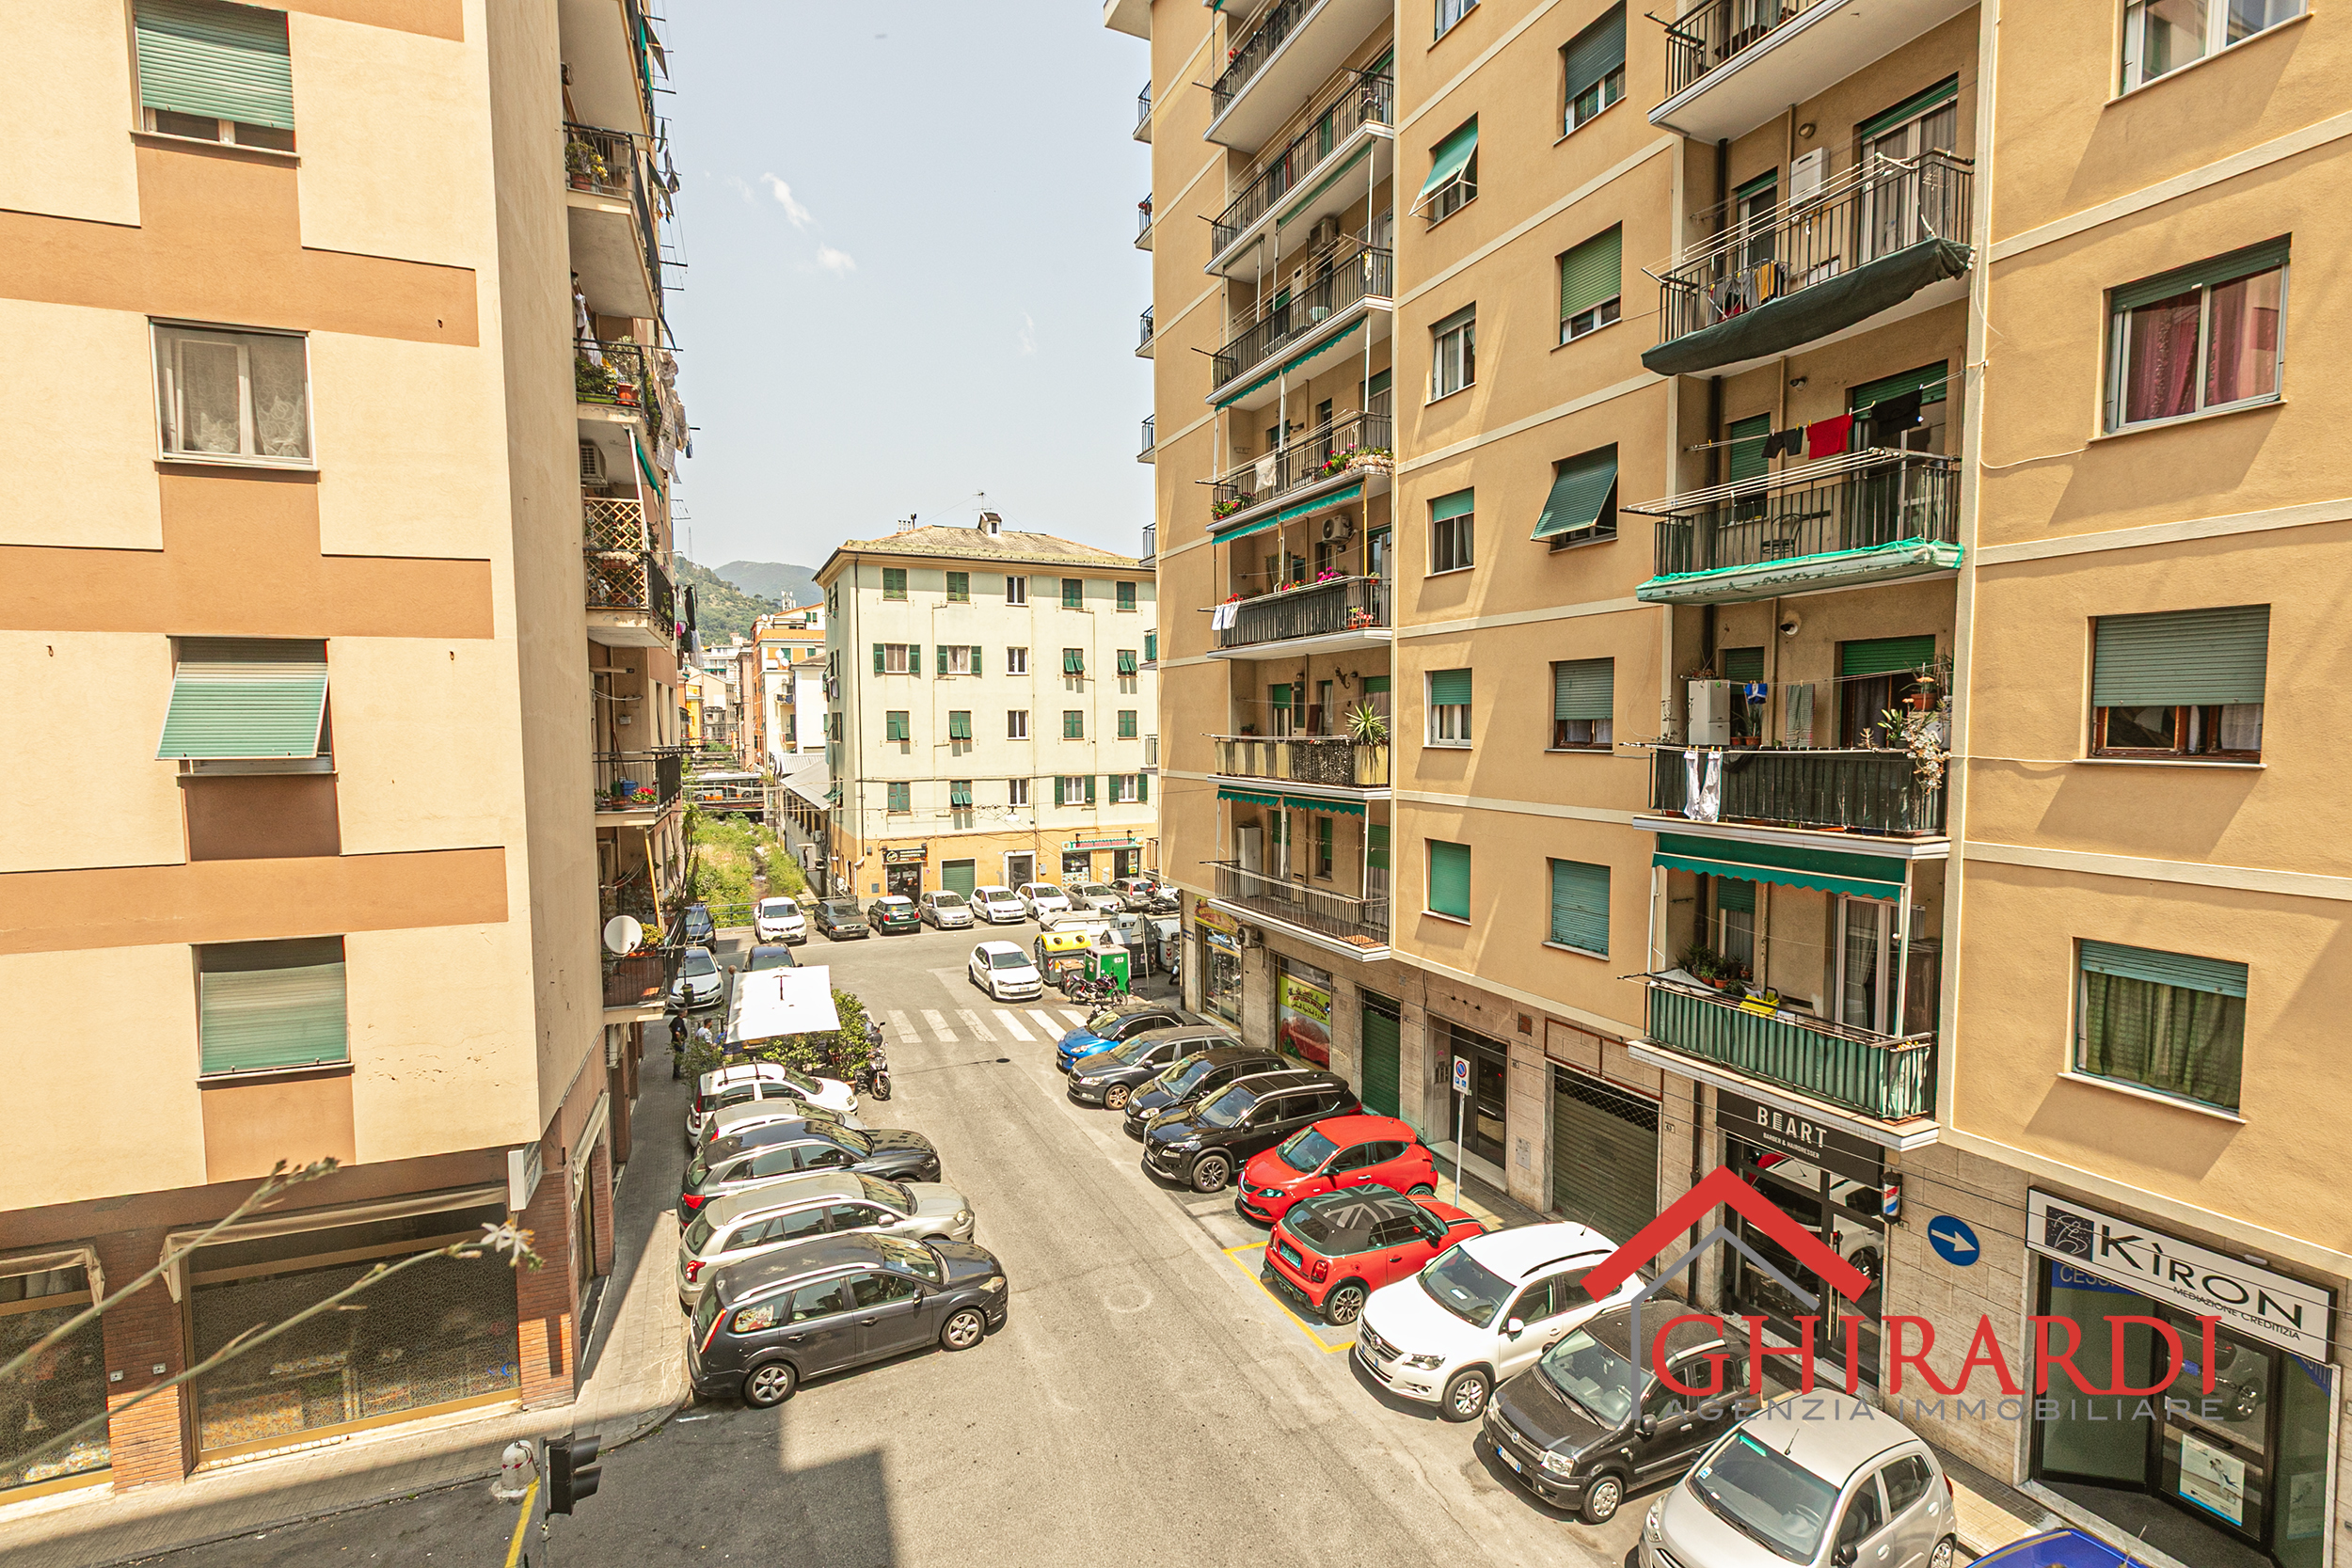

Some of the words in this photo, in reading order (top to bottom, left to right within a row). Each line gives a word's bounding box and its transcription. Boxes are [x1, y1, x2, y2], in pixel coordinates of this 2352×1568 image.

[1756, 1105, 1827, 1148] BEART
[1762, 1132, 1781, 1145] BARBER
[1787, 1141, 1820, 1160] HAIRDRESSER
[2173, 1286, 2238, 1317] MEDIAZIONE
[2240, 1312, 2301, 1341] CREDITIZIA
